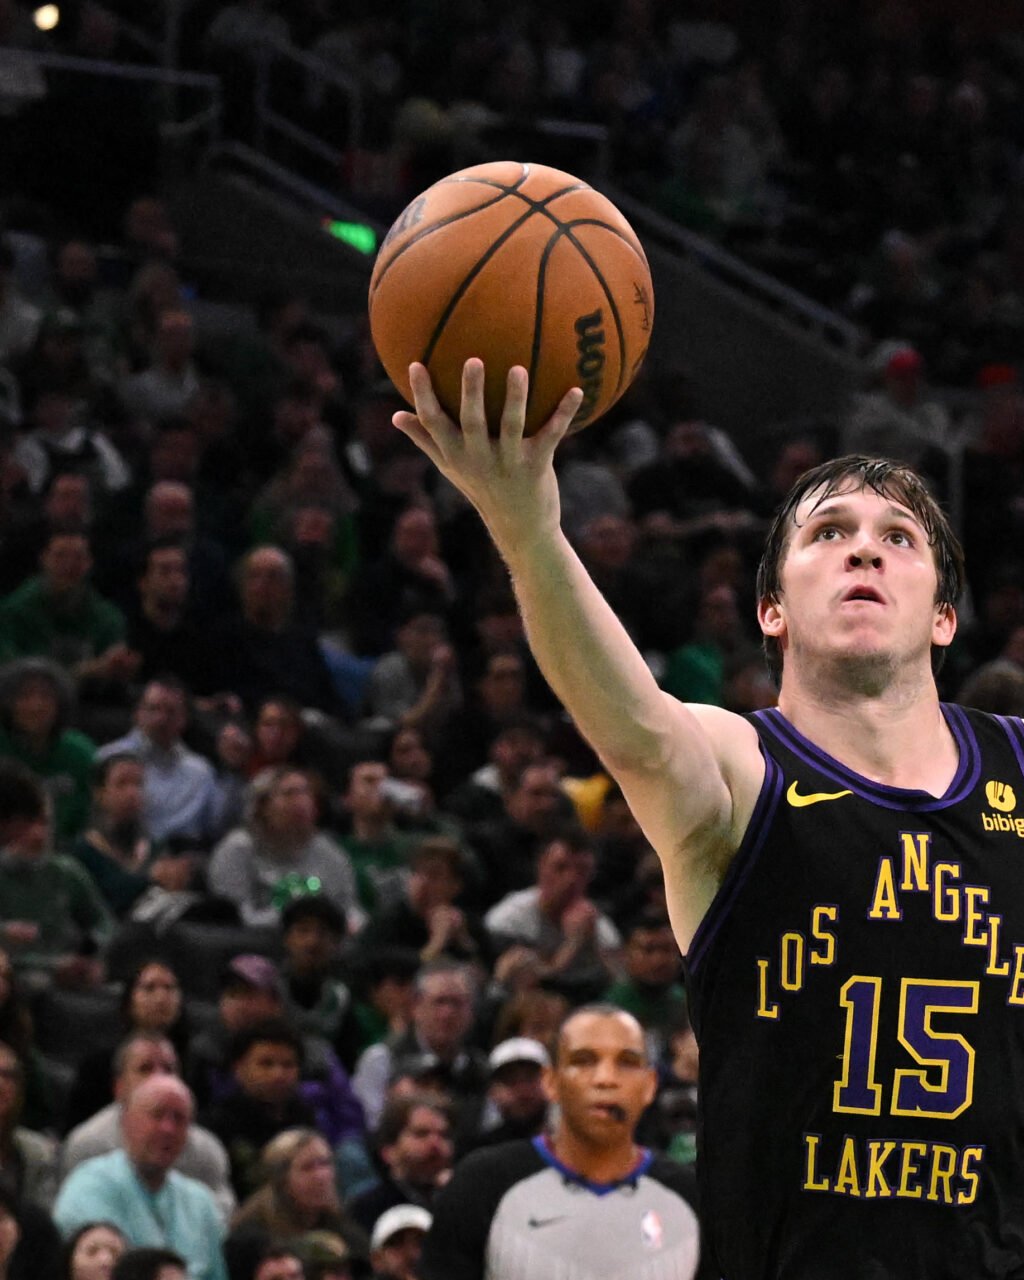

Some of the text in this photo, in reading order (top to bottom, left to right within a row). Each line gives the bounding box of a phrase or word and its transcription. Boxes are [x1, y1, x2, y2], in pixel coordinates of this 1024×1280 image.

[756, 905, 838, 1020] LOS
[833, 975, 980, 1120] 15
[803, 1135, 983, 1205] LAKERS
